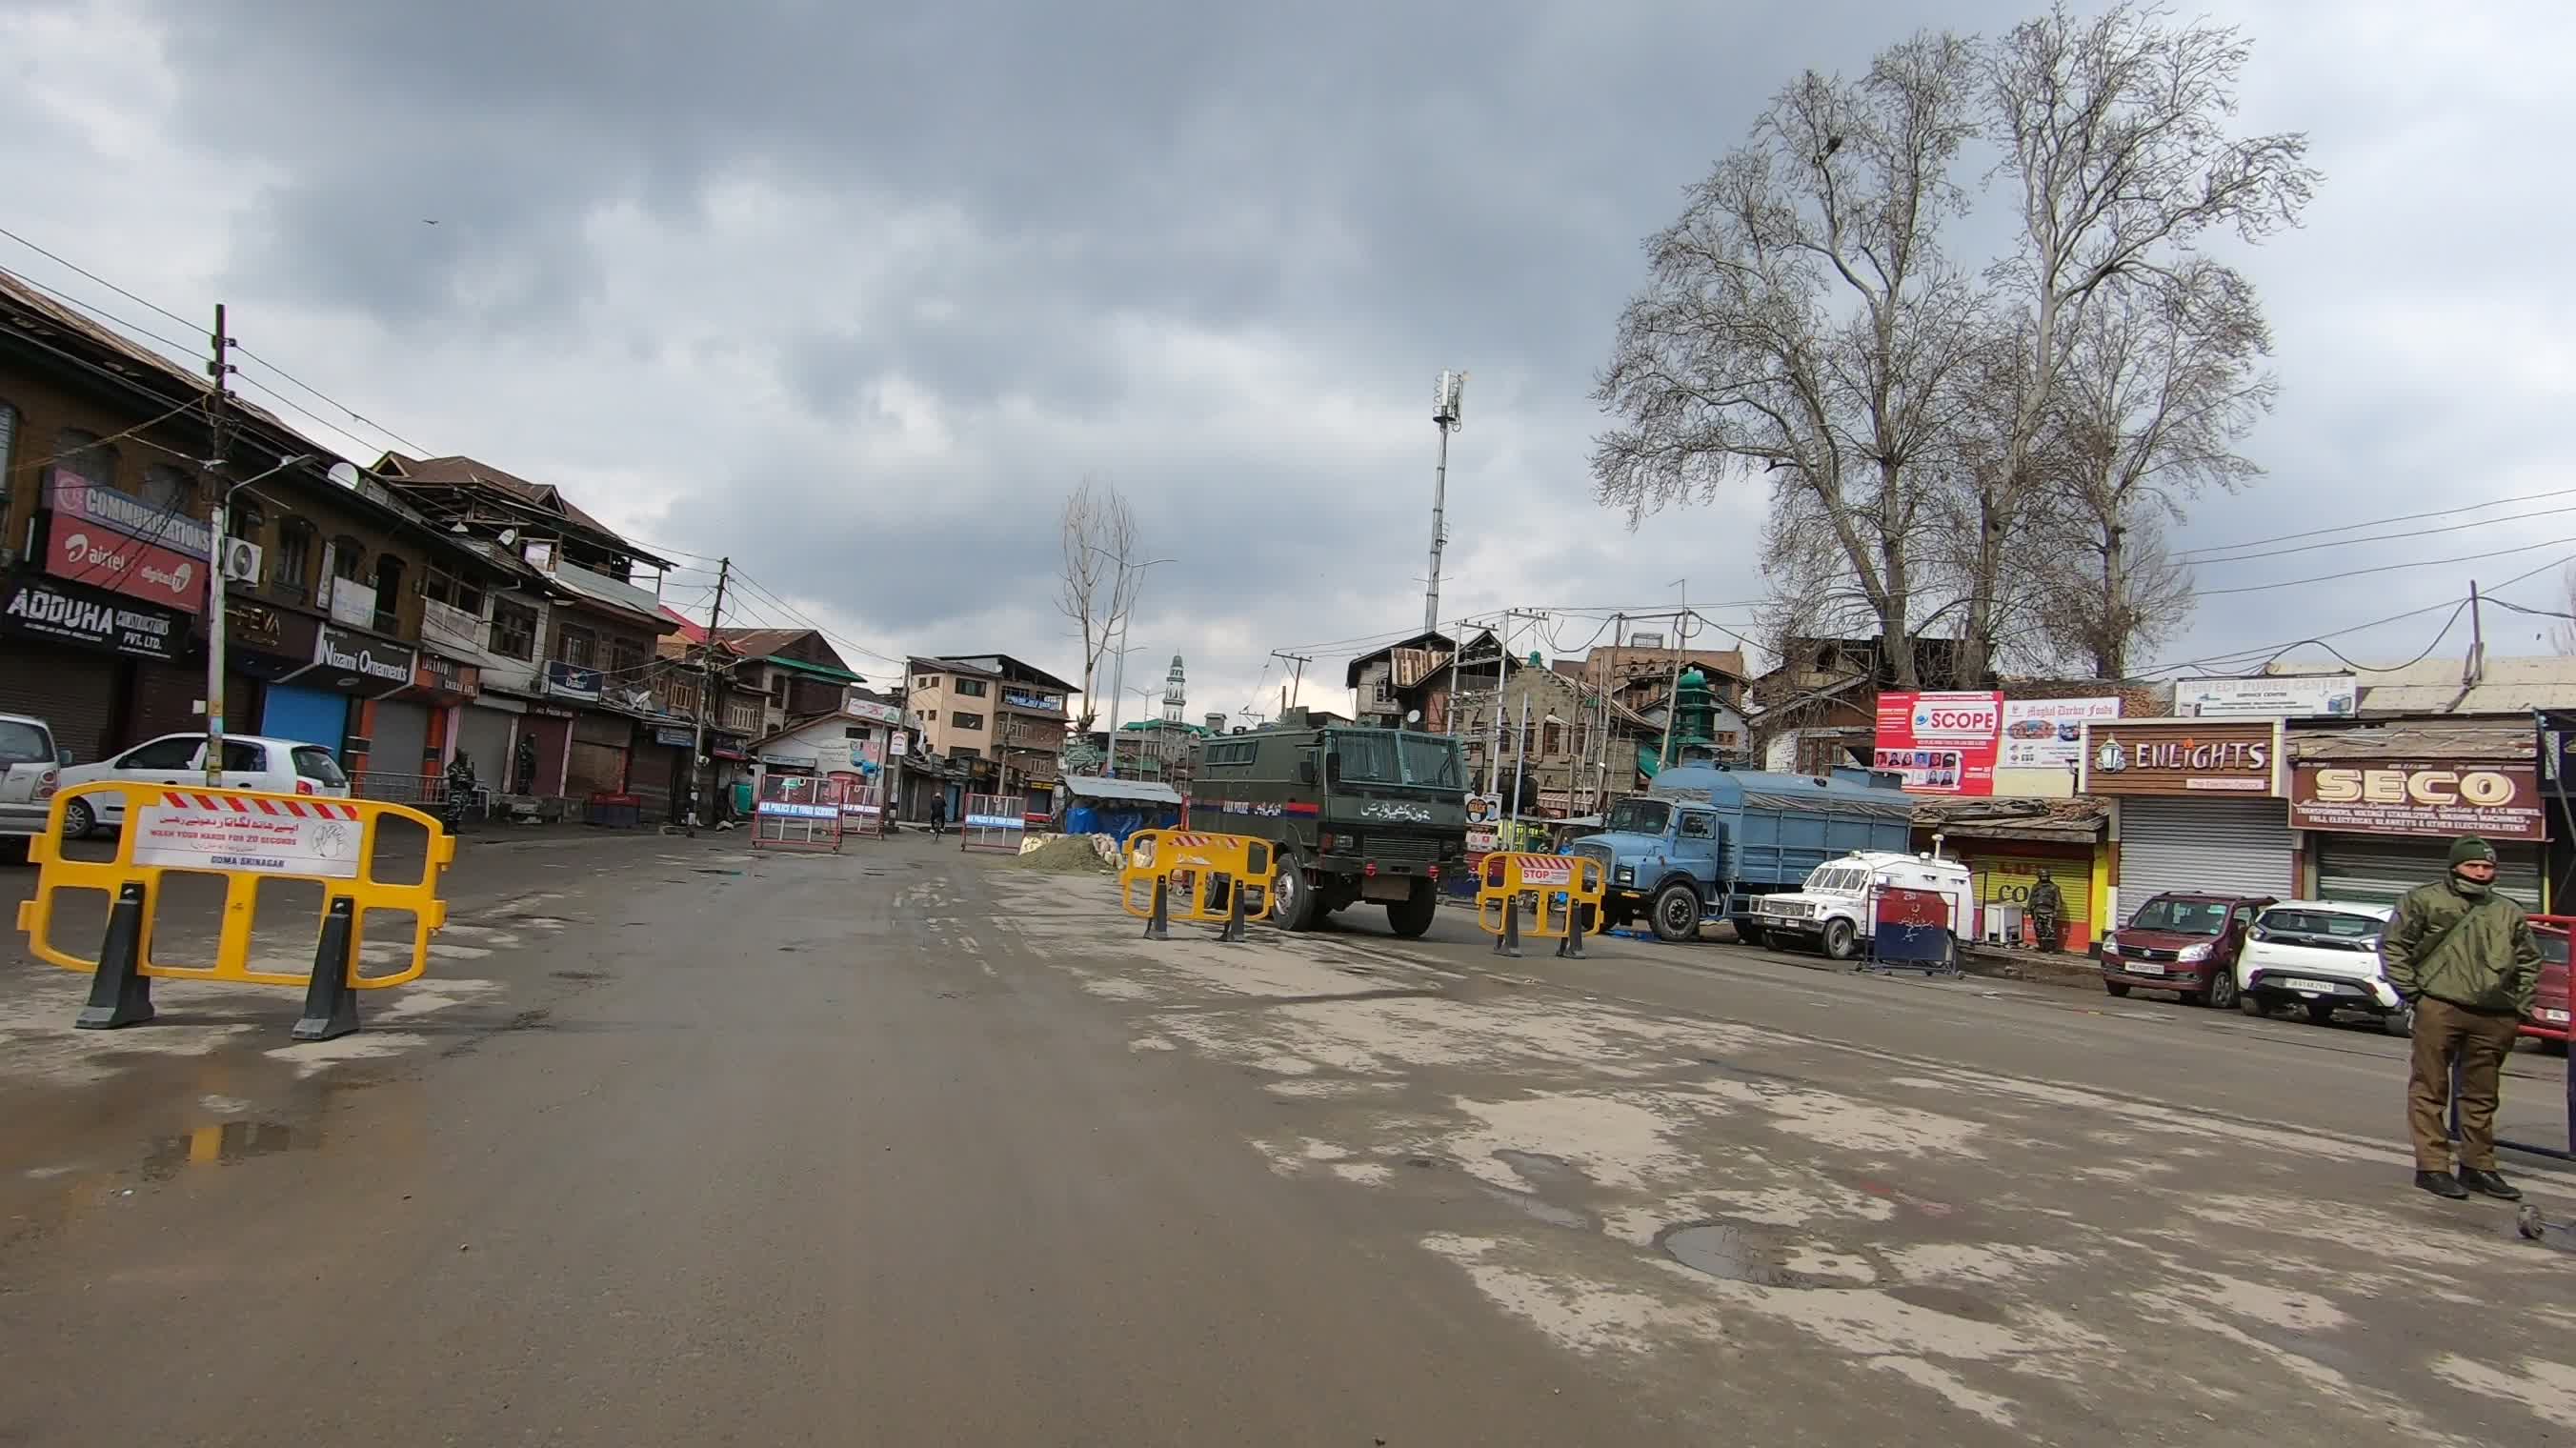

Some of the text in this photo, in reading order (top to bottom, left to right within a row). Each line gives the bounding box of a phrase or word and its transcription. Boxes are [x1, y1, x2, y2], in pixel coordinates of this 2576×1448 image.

[89, 546, 126, 572] airtel
[6, 587, 113, 634] ADDUHA
[319, 639, 358, 670] Nizami
[359, 649, 408, 682] Ornaments
[1930, 713, 1994, 729] SCOPE
[2316, 769, 2516, 807] SECO
[151, 829, 174, 837] WASH
[177, 831, 199, 839] YOUR
[228, 834, 245, 842] FOR
[246, 835, 259, 843] 20
[260, 837, 297, 846] SECONDS
[240, 855, 286, 868] SRINAGAR
[1523, 870, 1550, 879] STOP
